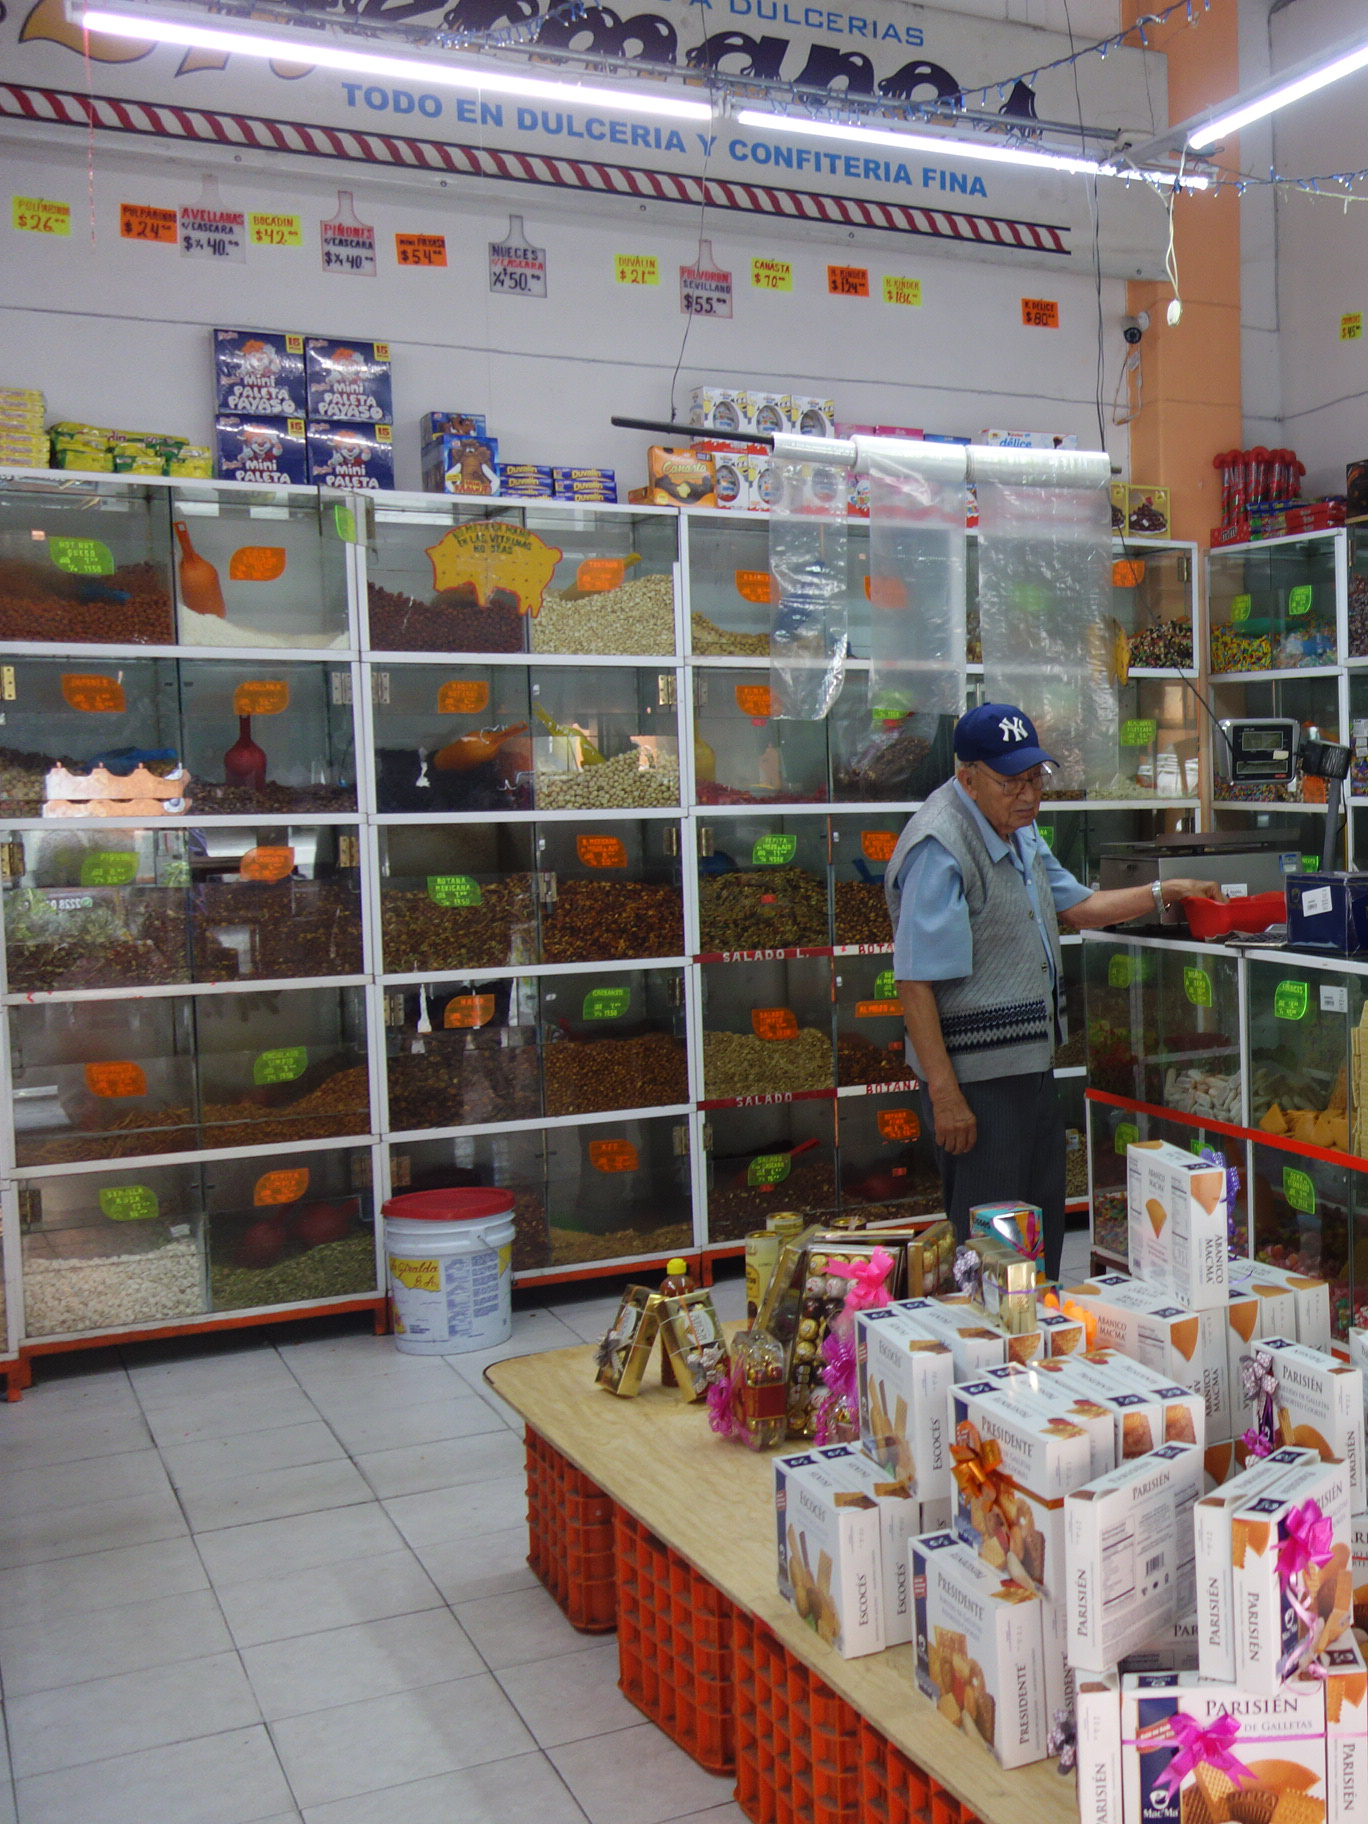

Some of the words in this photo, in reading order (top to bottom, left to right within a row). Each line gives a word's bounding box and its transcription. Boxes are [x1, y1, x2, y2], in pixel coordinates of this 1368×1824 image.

[729, 0, 925, 47] DULCERIAS
[341, 82, 443, 119] TODO
[456, 97, 504, 129] EN
[516, 107, 686, 155] DULCERIA
[697, 133, 717, 158] Y
[728, 140, 913, 186] CONFITERIA
[922, 167, 988, 198] FINA
[181, 207, 245, 226] AVELLANAS
[253, 215, 294, 227] BOCADIN
[323, 223, 373, 240] PIÑONES
[492, 244, 539, 262] NUECES
[617, 255, 656, 268] DUVALIN
[754, 259, 791, 275] CANASTA
[683, 279, 732, 295] SEVILLANO
[227, 396, 297, 414] PAYASO
[317, 401, 384, 421] PAYASO
[999, 437, 1033, 448] délice
[506, 464, 539, 477] Duvalin
[571, 468, 603, 480] Duvalin
[661, 460, 708, 475] Canasta
[507, 476, 541, 489] Duvalin
[573, 481, 604, 493] Duvalin
[998, 716, 1029, 742] NY
[722, 950, 785, 963] SALADO
[735, 1092, 793, 1108] SALADO
[1214, 1234, 1223, 1285] ABANICO
[1097, 1315, 1128, 1331] ABANICO
[1282, 1364, 1324, 1395] PARISIÉN
[932, 1416, 943, 1472] ESCOCÉS
[980, 1415, 1035, 1458] PRESIDENTE
[1349, 1429, 1357, 1488] PARISIÉN
[1132, 1470, 1171, 1501] PARISIÉN
[798, 1489, 828, 1525] ESCOCÉS
[896, 1561, 906, 1616] ESCOCÉS
[937, 1571, 985, 1622] PRESIDENTE
[857, 1572, 869, 1628] ESCOCÉS
[1076, 1568, 1088, 1637] PARISIÉN
[1208, 1576, 1221, 1647] PARISIÉN
[1247, 1591, 1260, 1663] PARISIÉN
[1018, 1662, 1029, 1746] PRESIDENTE
[1205, 1693, 1299, 1718] PARISIÉN
[1244, 1725, 1259, 1734] DE
[1260, 1719, 1313, 1732] GALLETAS
[1342, 1743, 1355, 1812] PARISIÉN
[1143, 1806, 1179, 1819] Mac'Ma
